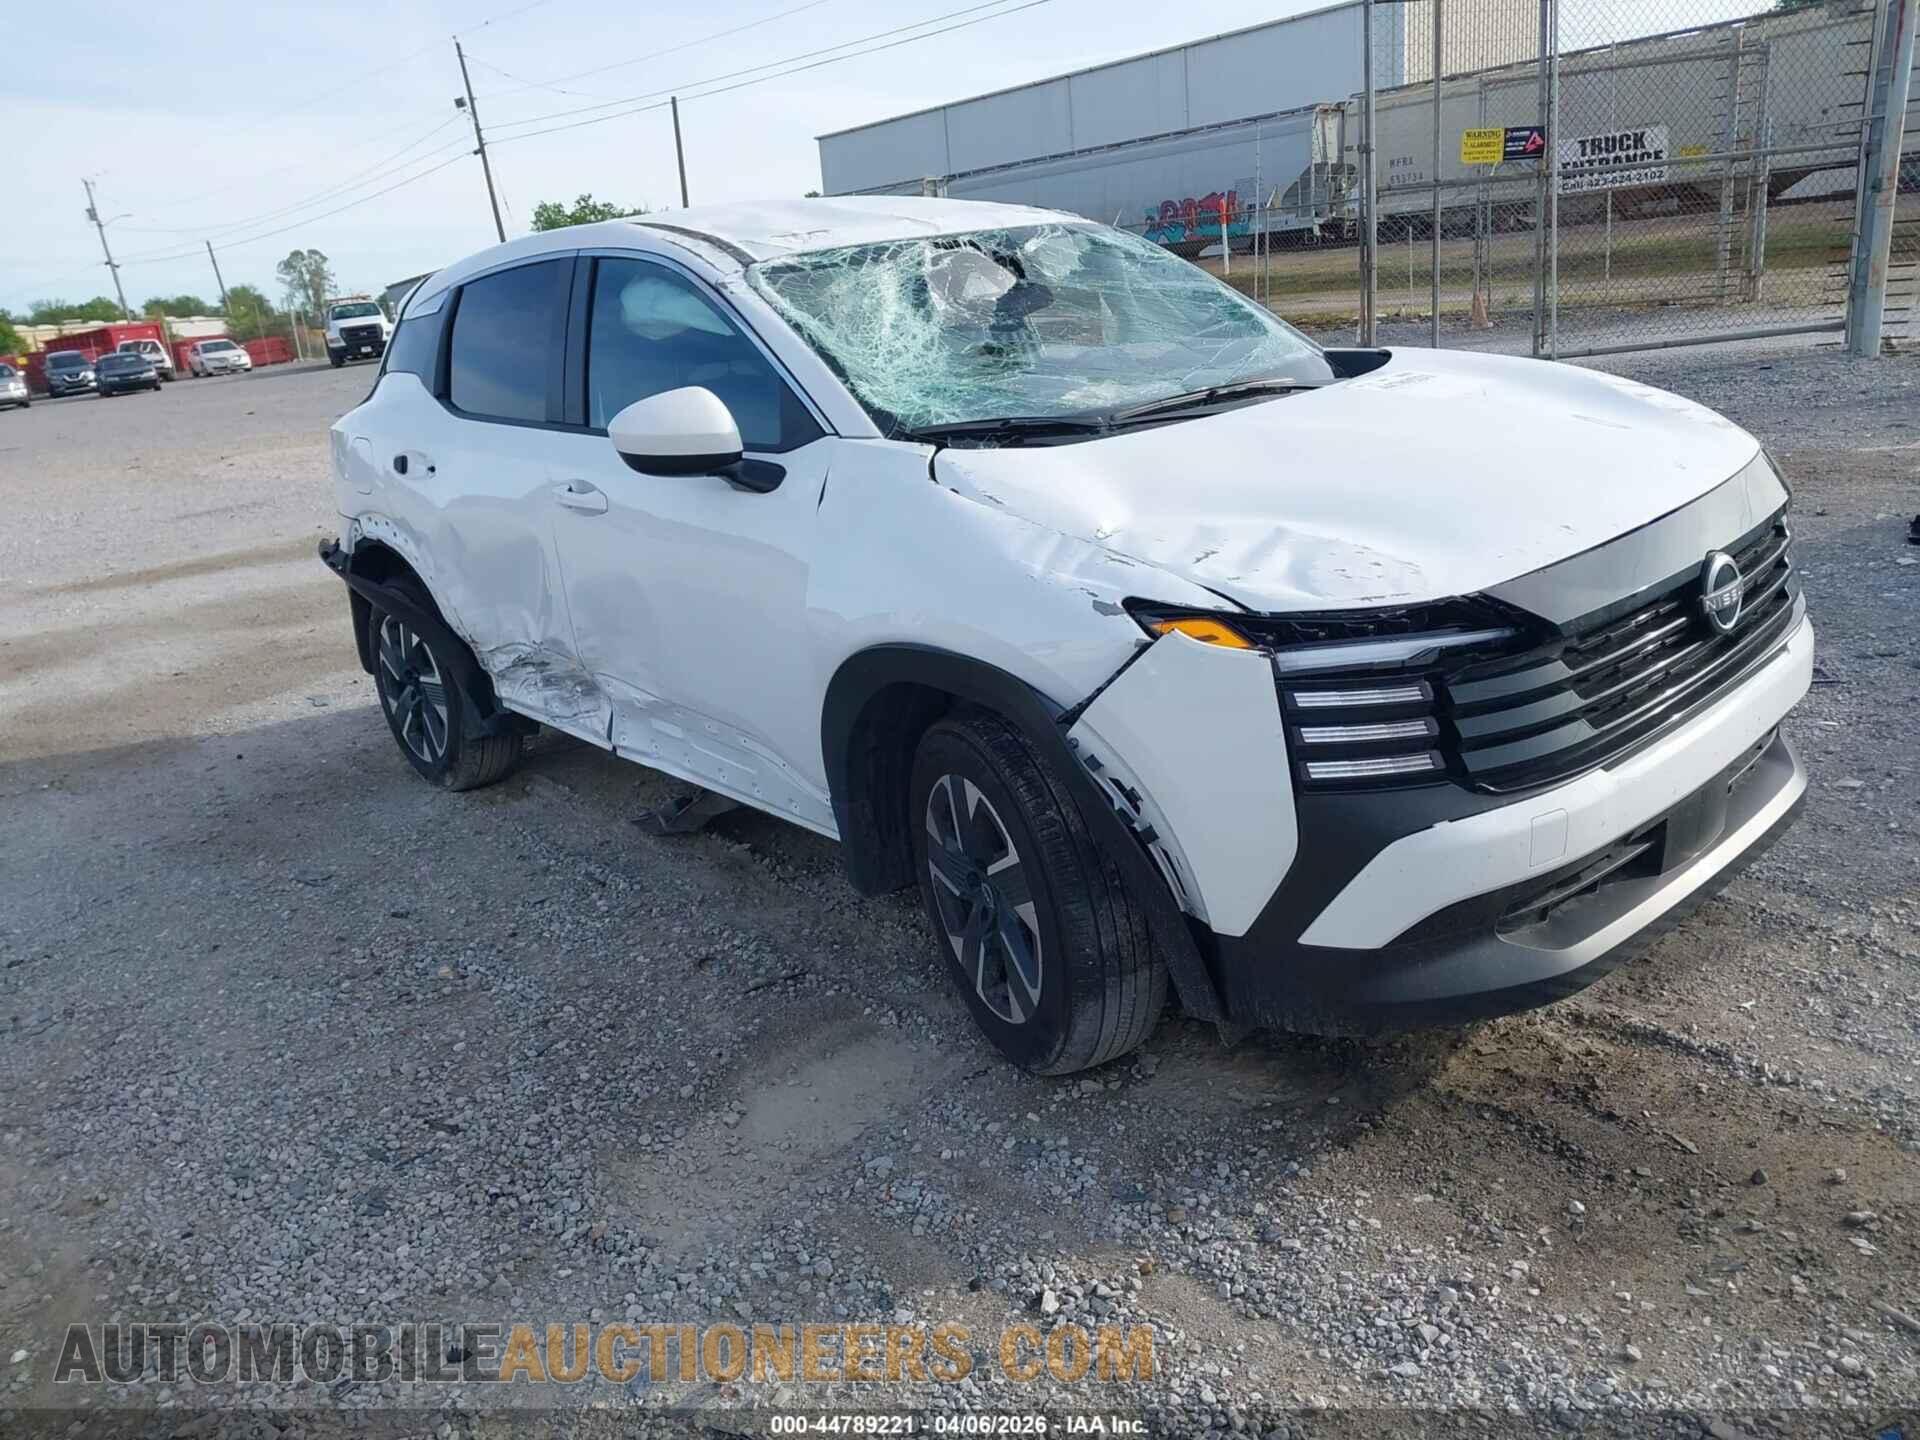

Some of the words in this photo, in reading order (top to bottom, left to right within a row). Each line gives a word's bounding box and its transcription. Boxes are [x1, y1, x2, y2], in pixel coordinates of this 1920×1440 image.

[1465, 130, 1501, 138] WARNING
[1577, 131, 1647, 158] TRUCK
[1703, 587, 1744, 614] NISS
